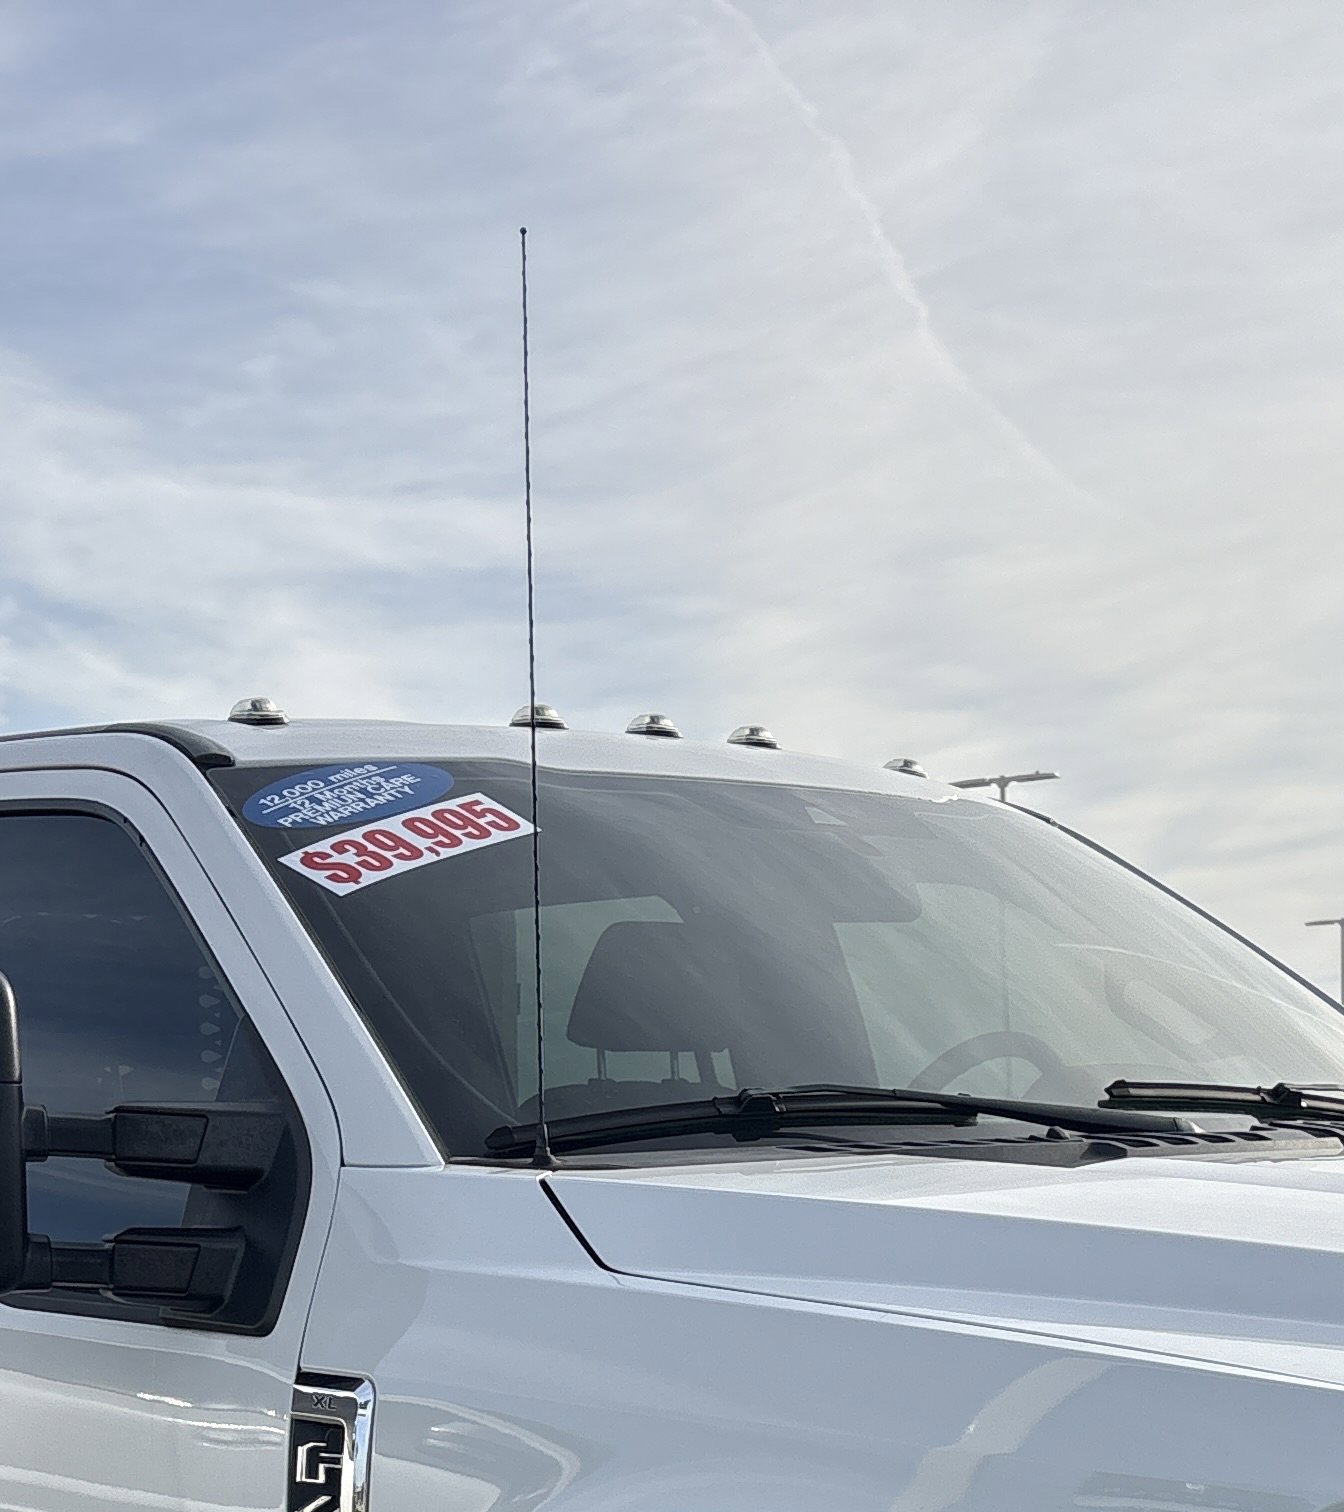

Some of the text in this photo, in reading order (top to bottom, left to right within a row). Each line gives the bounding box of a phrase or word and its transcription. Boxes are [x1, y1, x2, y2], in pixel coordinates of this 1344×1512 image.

[258, 765, 378, 807] 12,000 miles
[289, 776, 386, 813] 12 Months
[367, 774, 422, 795] CARE
[308, 786, 415, 826] WARRANTY
[299, 800, 522, 885] $39,995
[312, 1394, 337, 1411] XL
